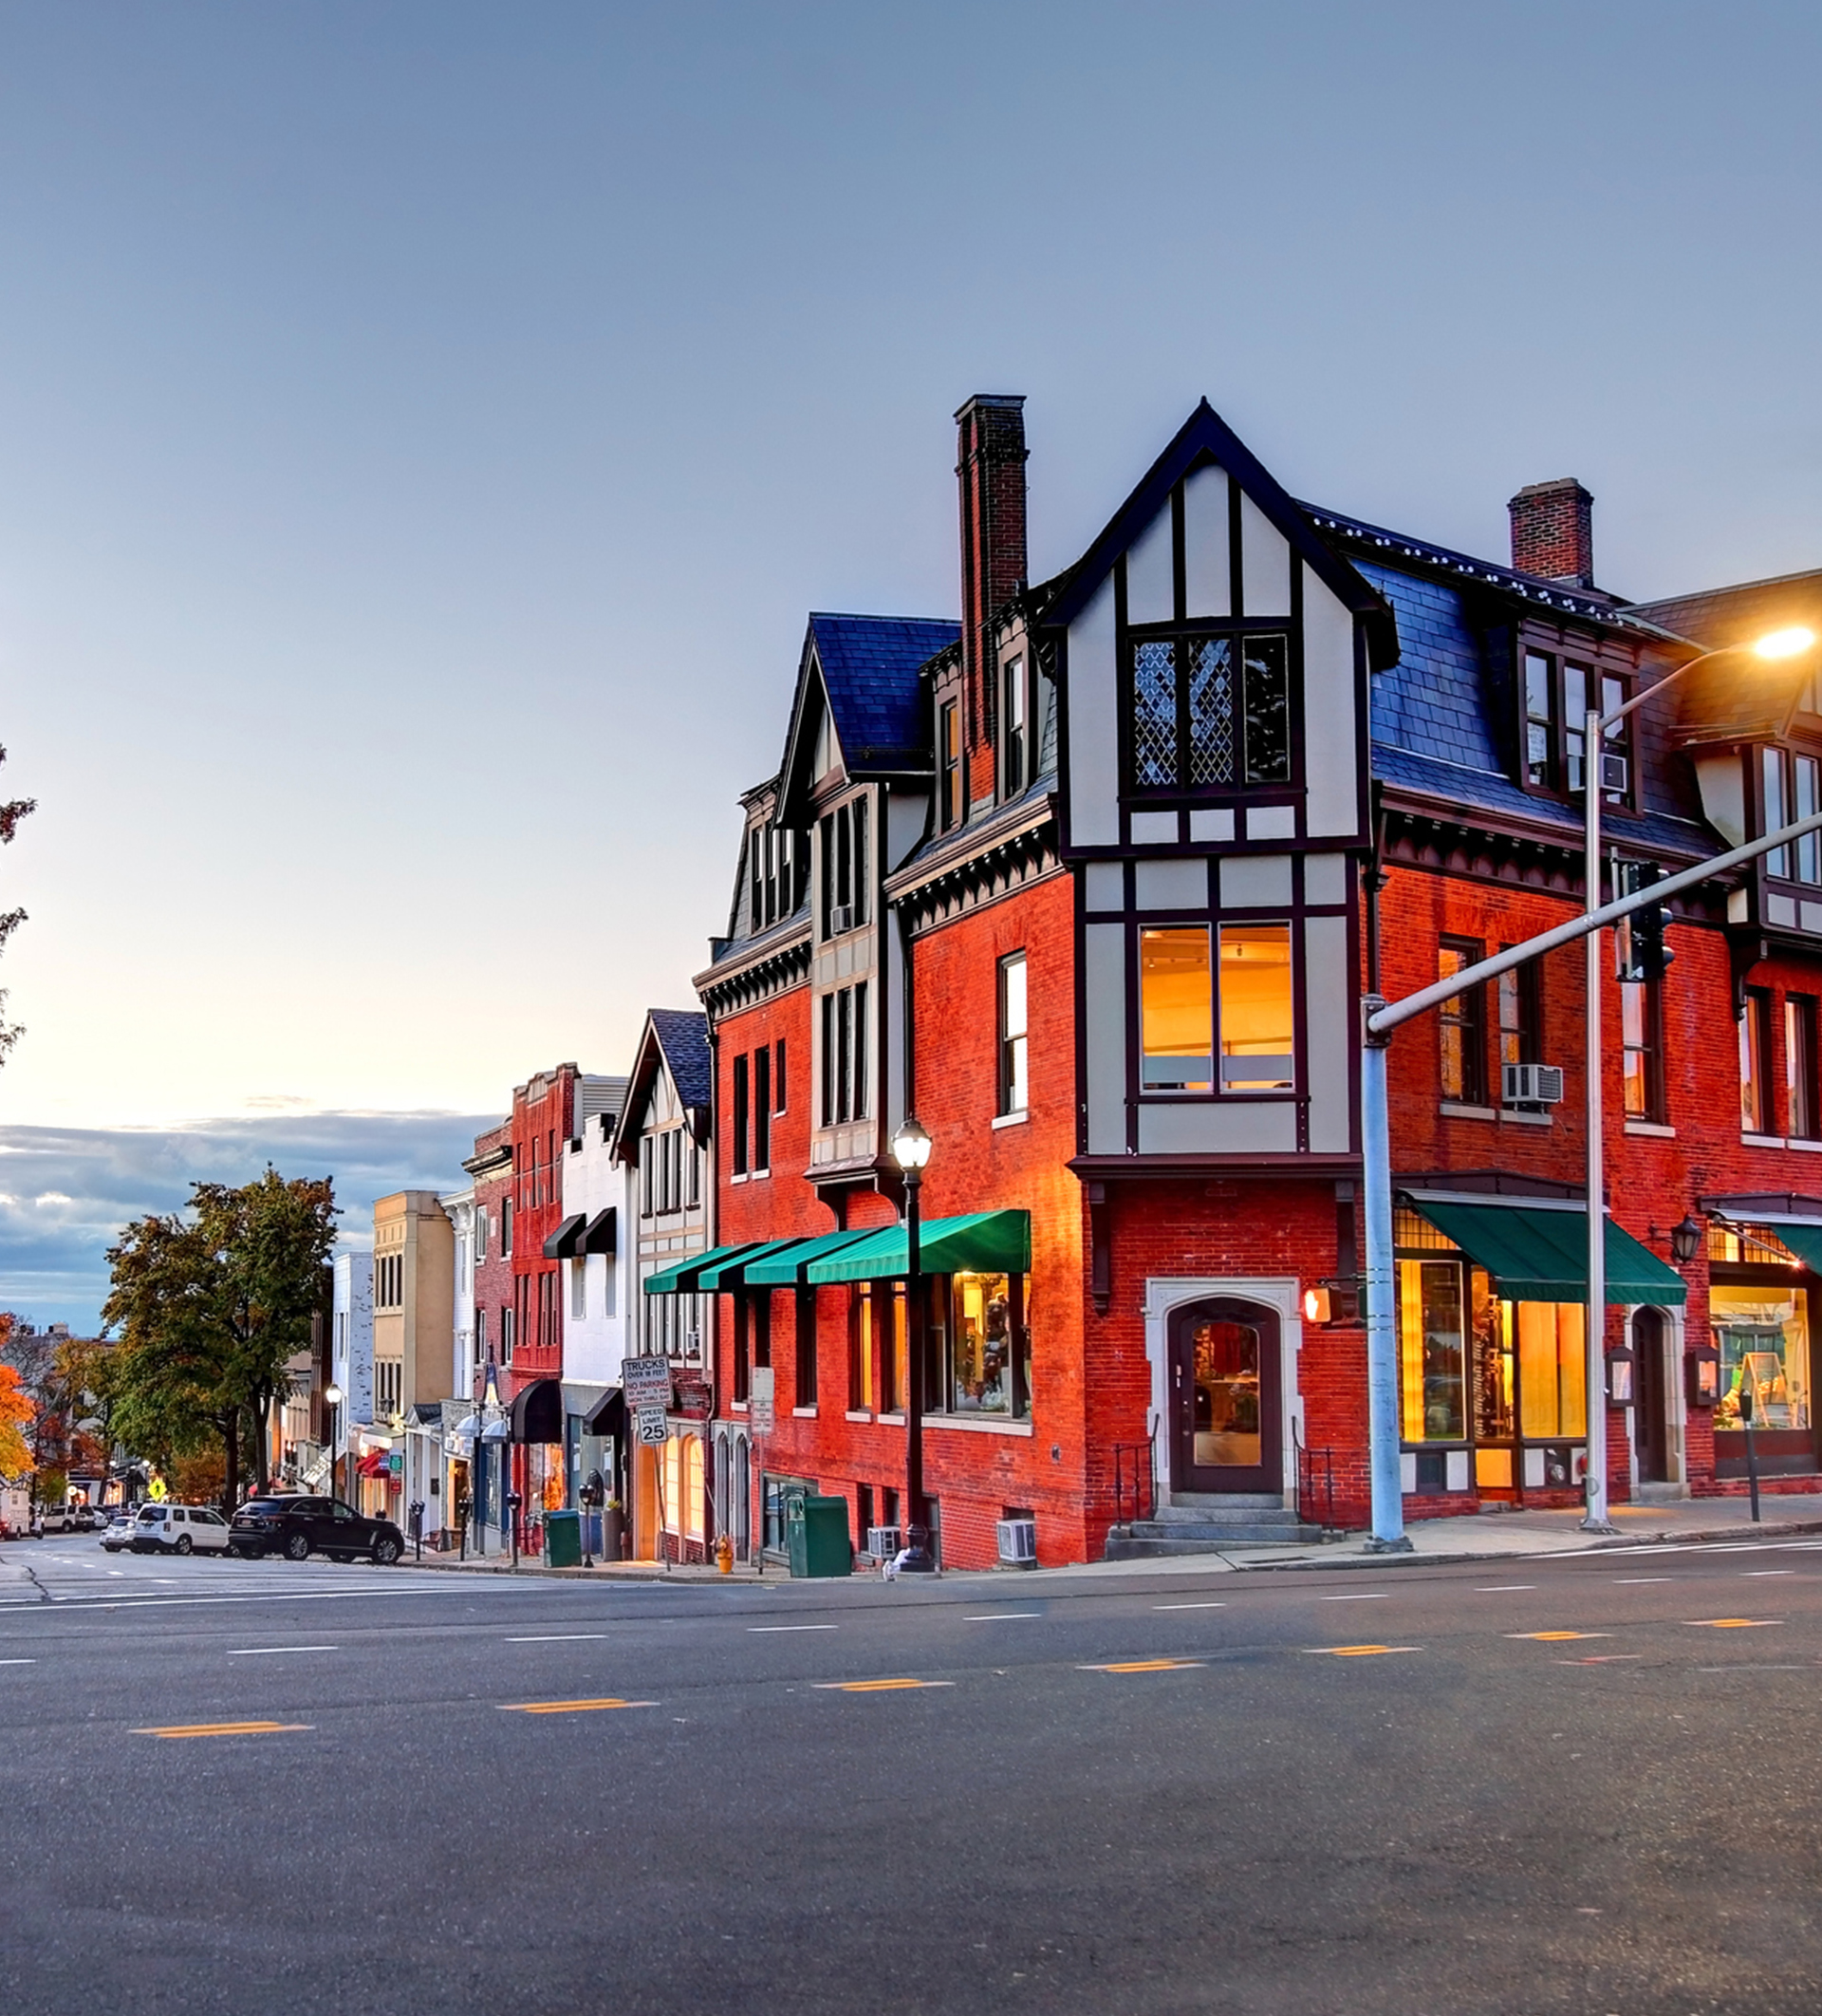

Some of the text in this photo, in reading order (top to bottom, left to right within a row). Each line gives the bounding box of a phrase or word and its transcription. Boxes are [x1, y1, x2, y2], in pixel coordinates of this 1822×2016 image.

[626, 1358, 665, 1371] TRUCKS
[627, 1371, 643, 1379] OVER
[626, 1378, 669, 1391] NO PARKING
[642, 1416, 660, 1425] LIMIT
[642, 1425, 664, 1440] 25
